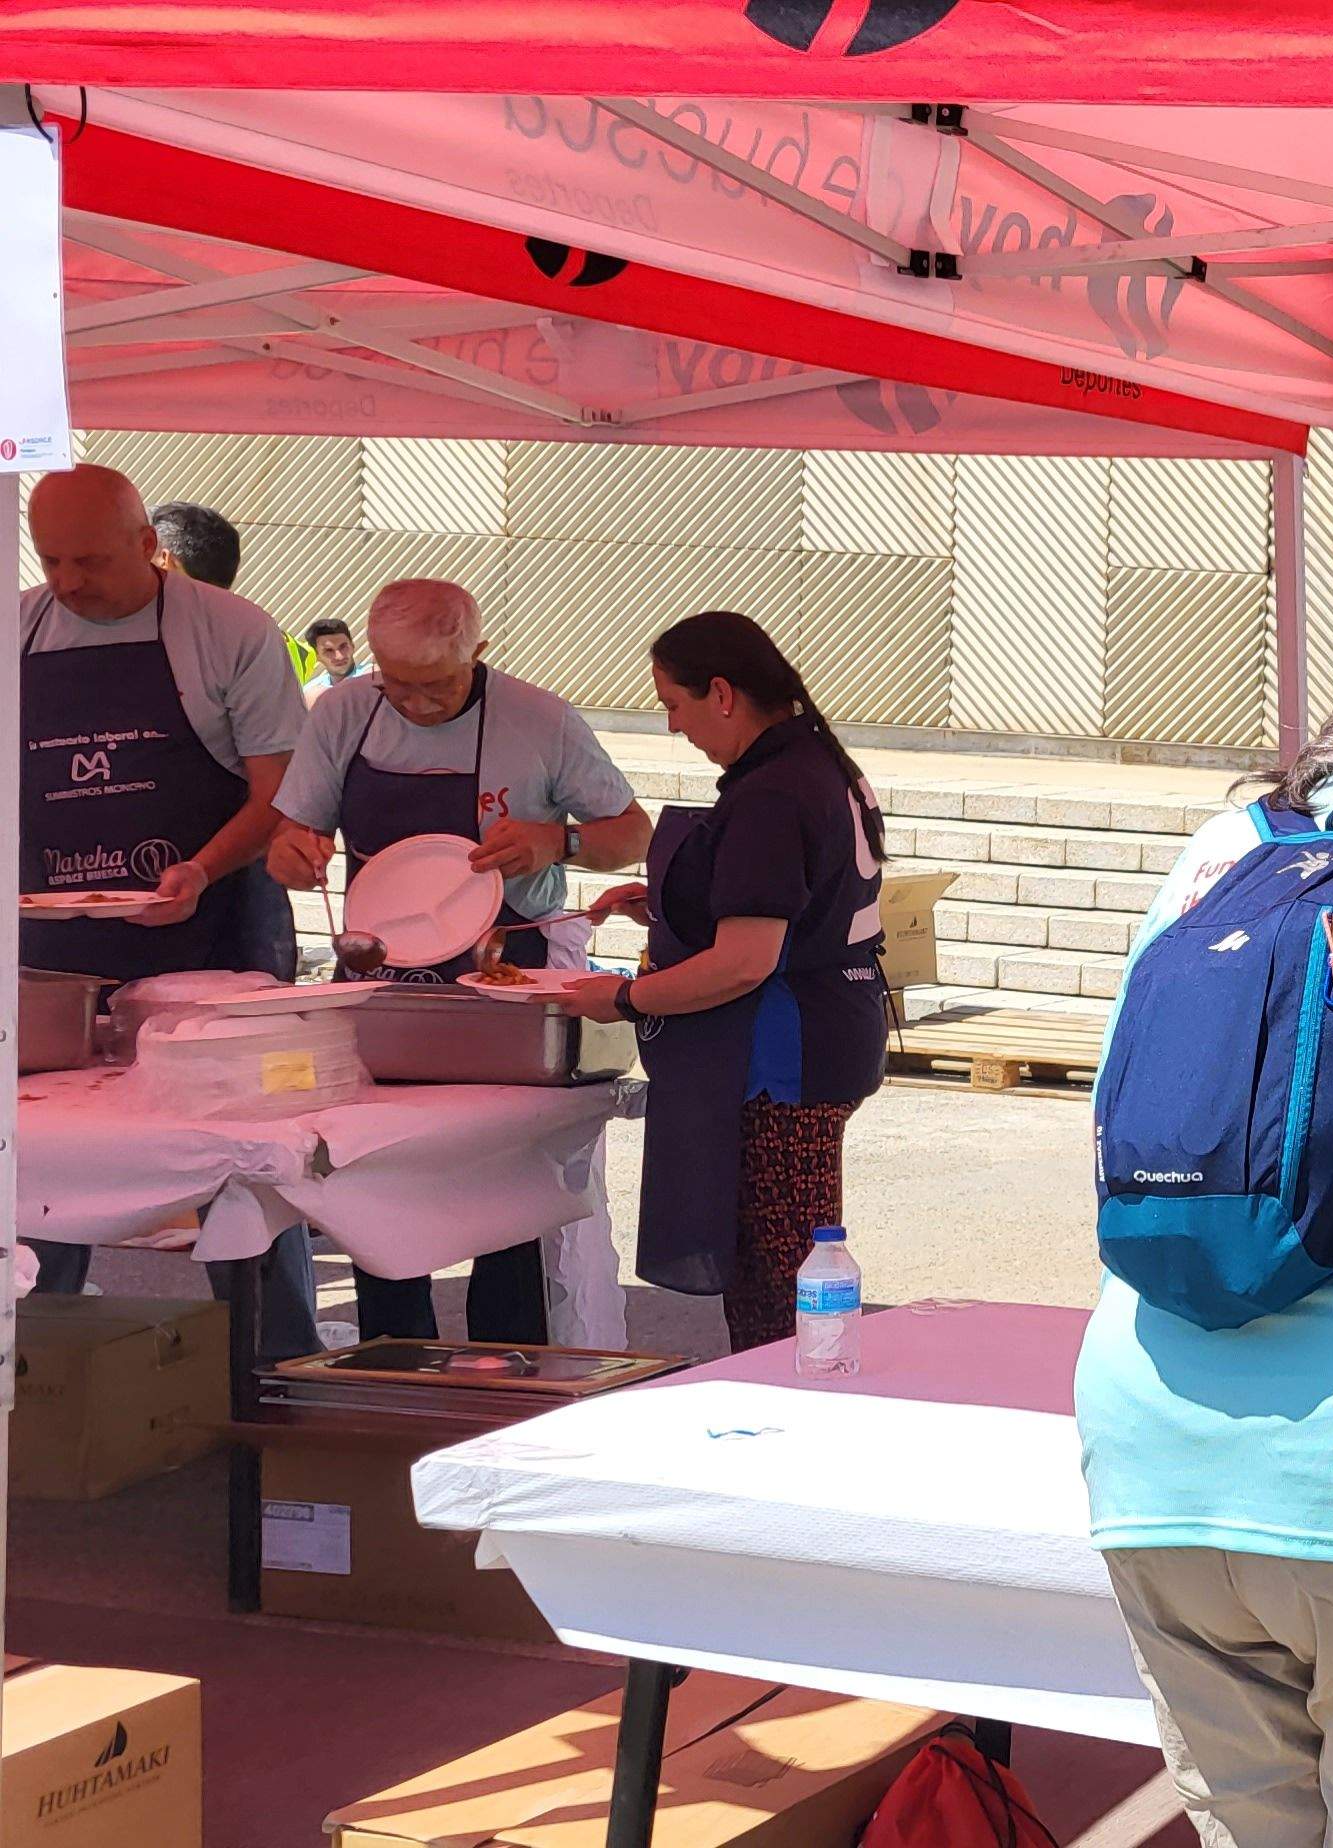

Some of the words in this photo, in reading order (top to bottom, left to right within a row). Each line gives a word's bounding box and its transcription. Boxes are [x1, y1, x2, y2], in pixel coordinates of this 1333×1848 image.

[93, 729, 139, 742] laboral
[1133, 1170, 1204, 1184] Quechua
[37, 1744, 171, 1818] HUHTAMAKI
